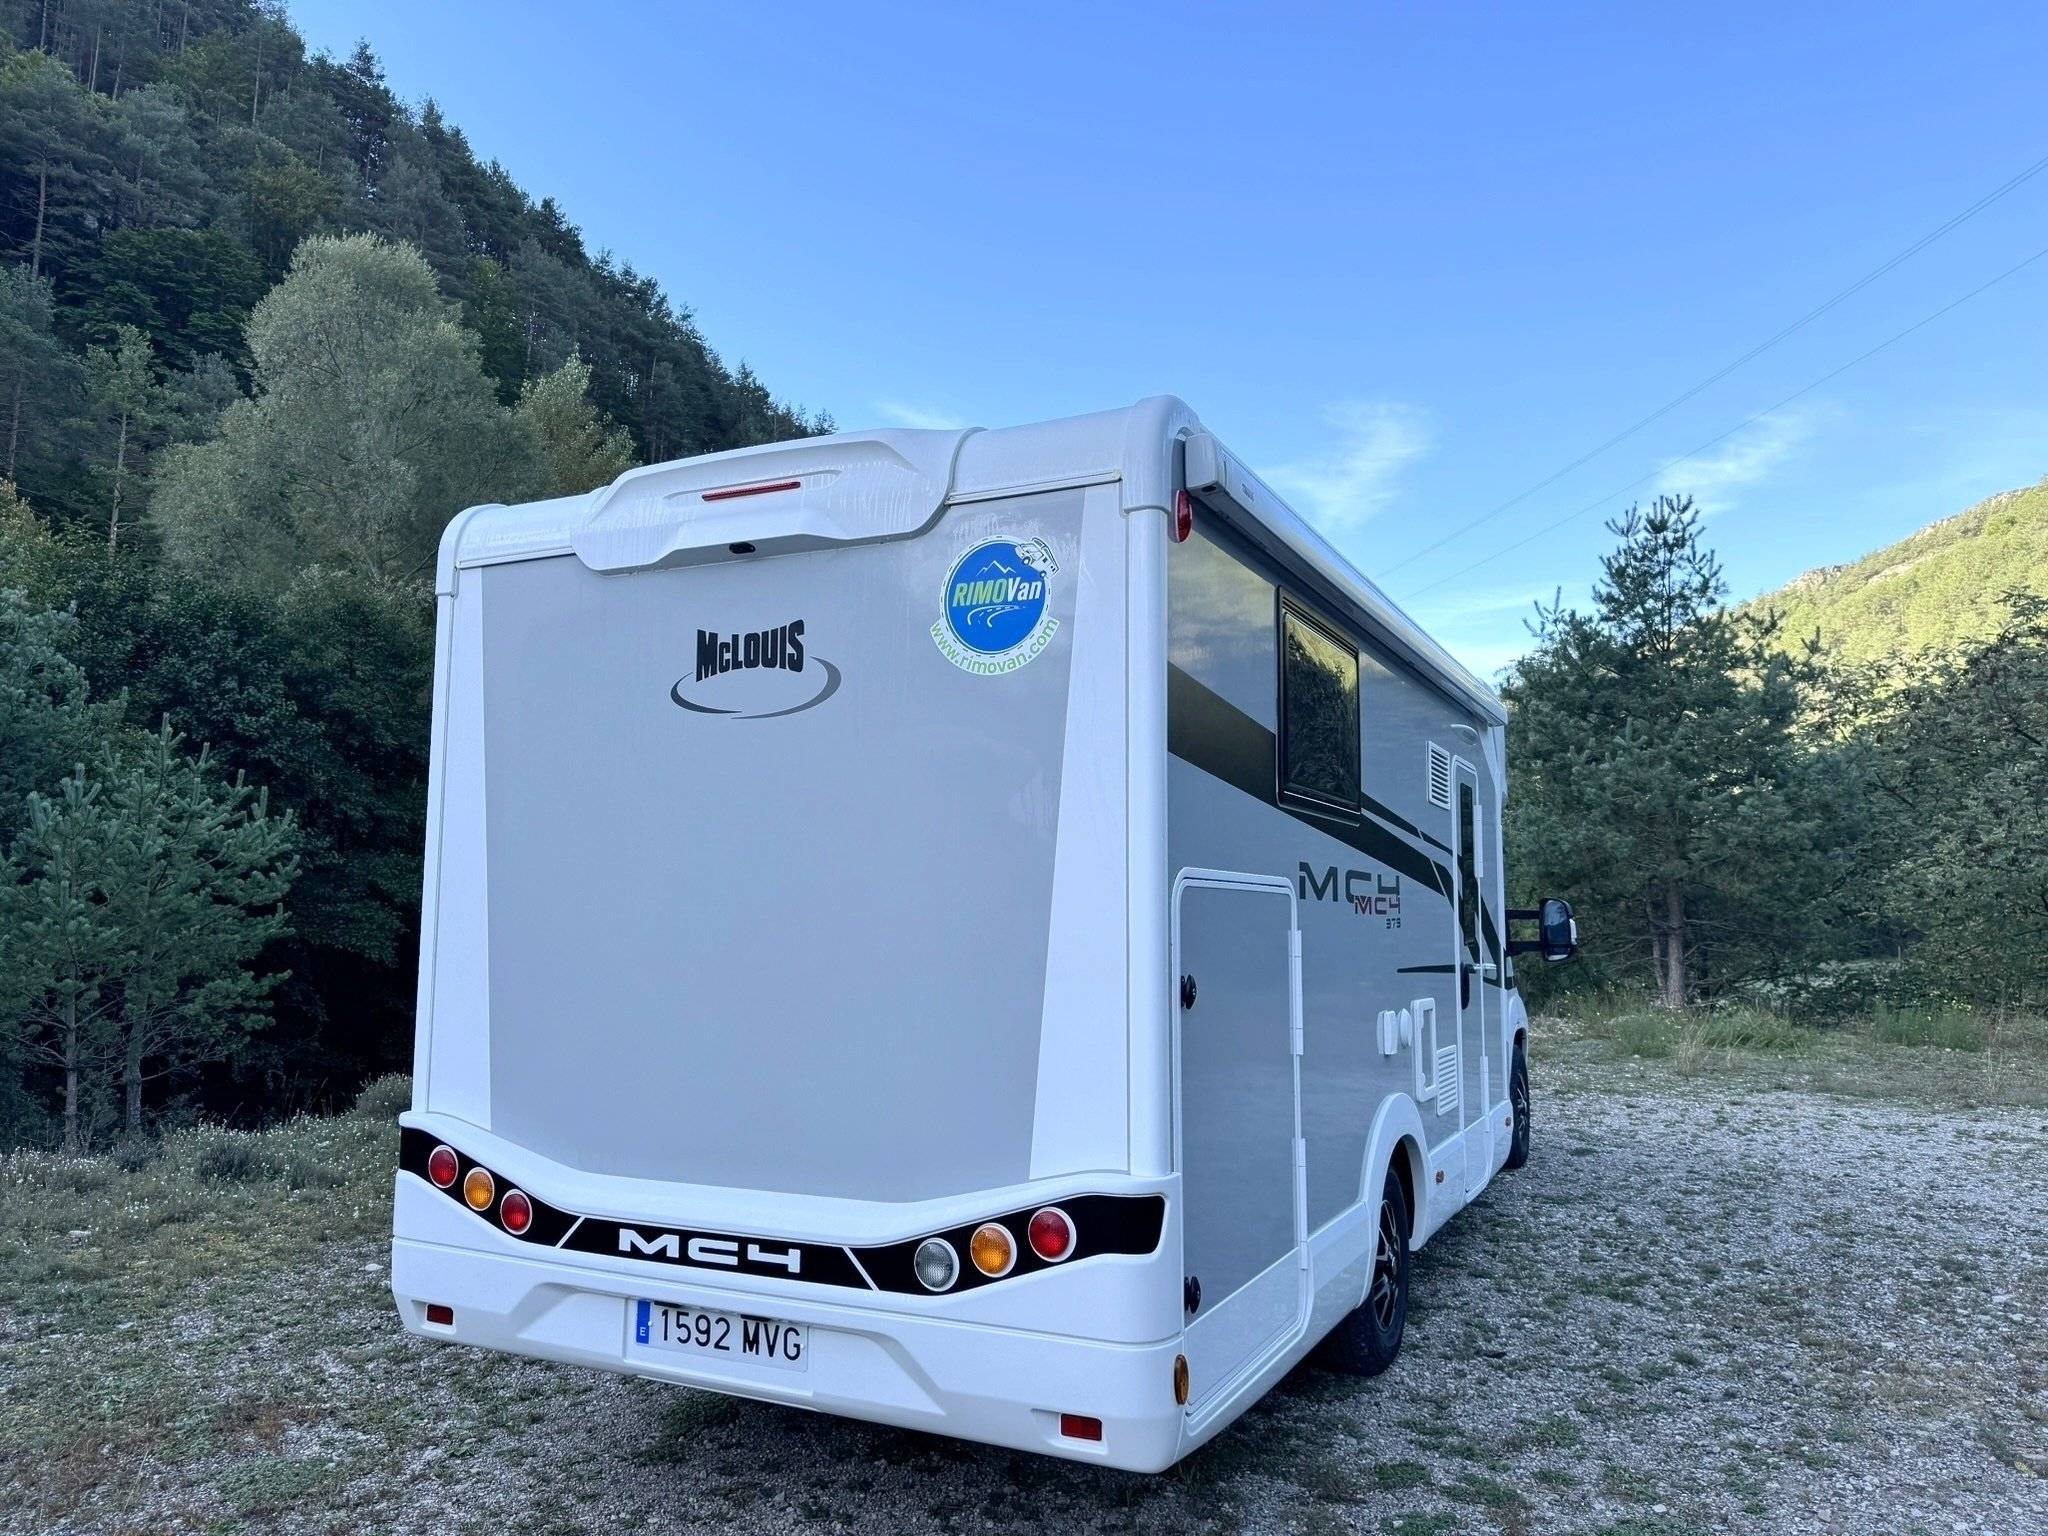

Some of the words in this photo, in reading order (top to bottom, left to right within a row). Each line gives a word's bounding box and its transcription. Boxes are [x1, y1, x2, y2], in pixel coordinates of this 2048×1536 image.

[952, 577, 1042, 607] RIMOVan
[696, 619, 805, 682] McLOUIS
[931, 619, 1058, 674] www.rimovan.com
[1299, 861, 1400, 903] MC4
[1354, 896, 1401, 915] MC4
[619, 1228, 800, 1273] MC4
[639, 1326, 646, 1337] E
[661, 1308, 730, 1351] 1592
[742, 1319, 801, 1361] MVG
